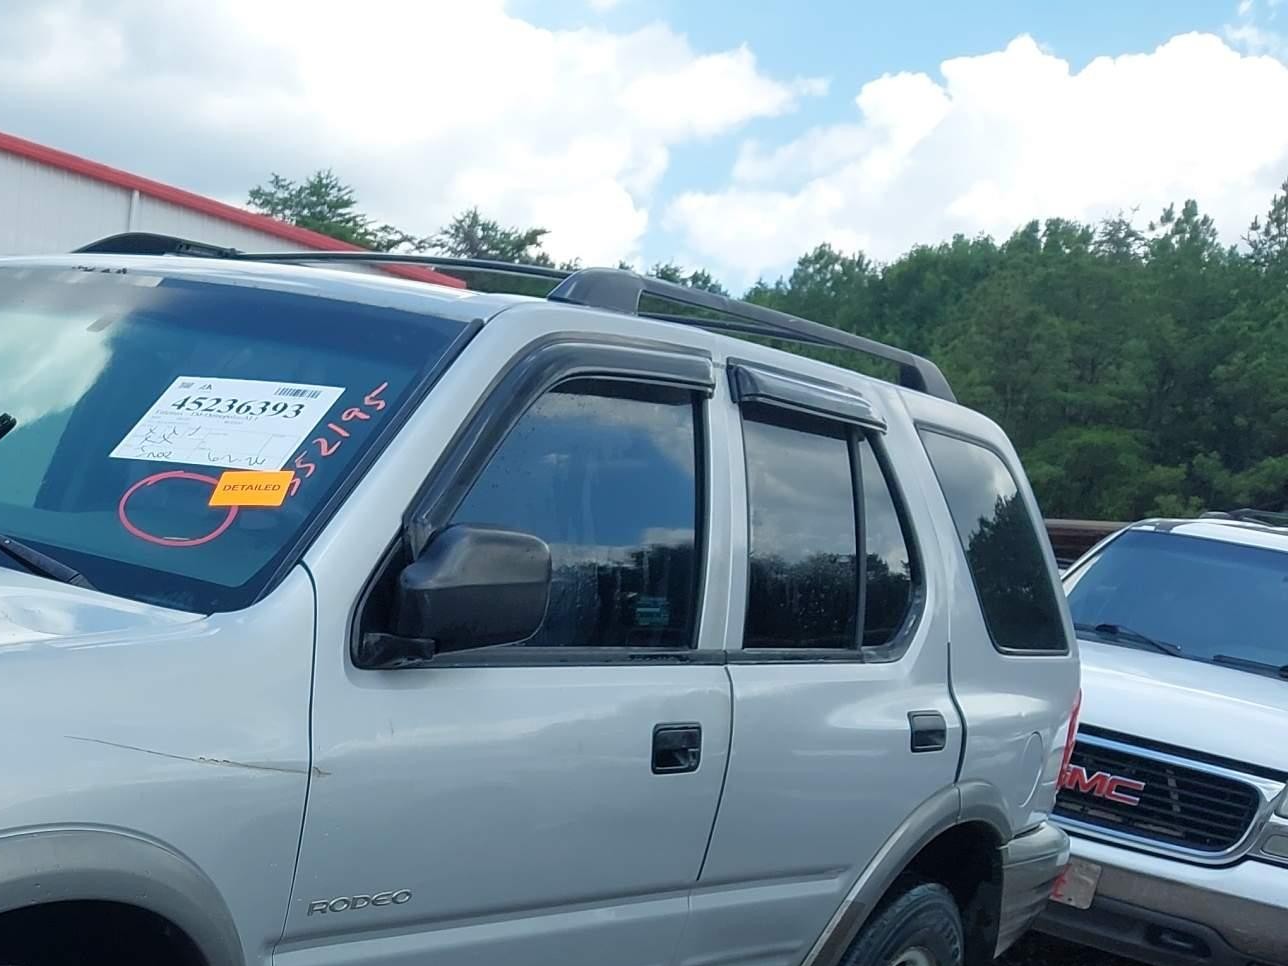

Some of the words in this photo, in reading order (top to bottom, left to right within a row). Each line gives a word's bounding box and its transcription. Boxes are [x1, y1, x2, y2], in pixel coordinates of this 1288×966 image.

[172, 395, 306, 419] 45236393
[223, 484, 281, 492] DETAILED
[1058, 763, 1146, 807] MC
[307, 888, 413, 917] RODEO
